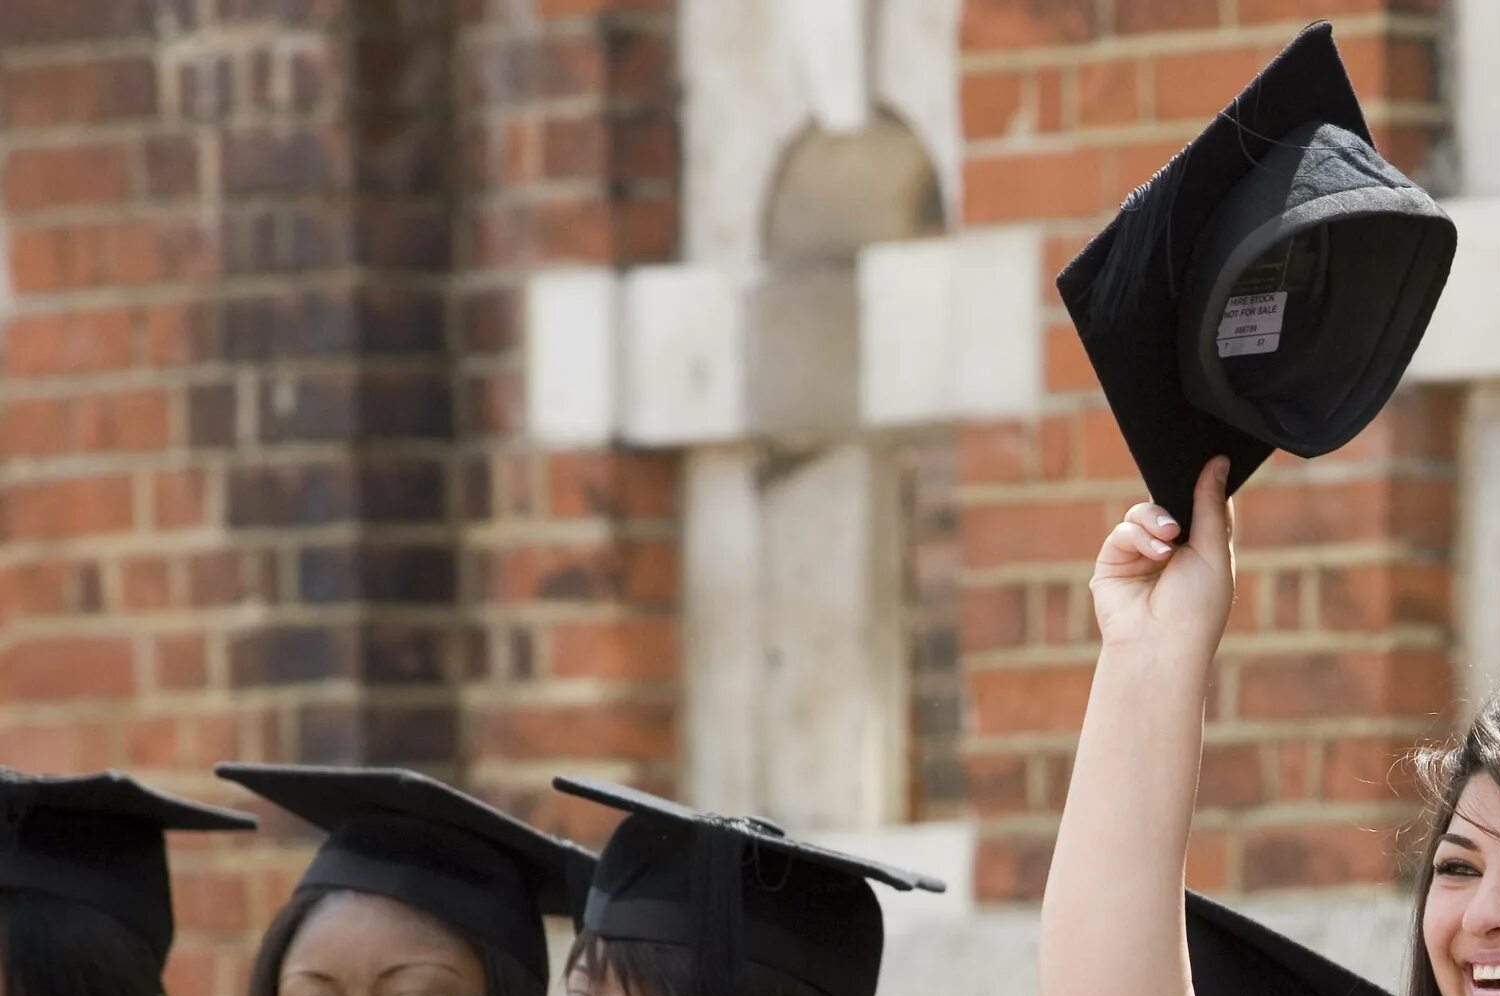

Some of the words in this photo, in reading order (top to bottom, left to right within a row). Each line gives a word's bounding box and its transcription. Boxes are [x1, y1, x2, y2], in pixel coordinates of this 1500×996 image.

[1230, 296, 1248, 306] HIRE
[1249, 294, 1275, 304] STOCK
[1223, 310, 1239, 319] NOT
[1240, 307, 1256, 316] FOR
[1257, 304, 1278, 315] SALE
